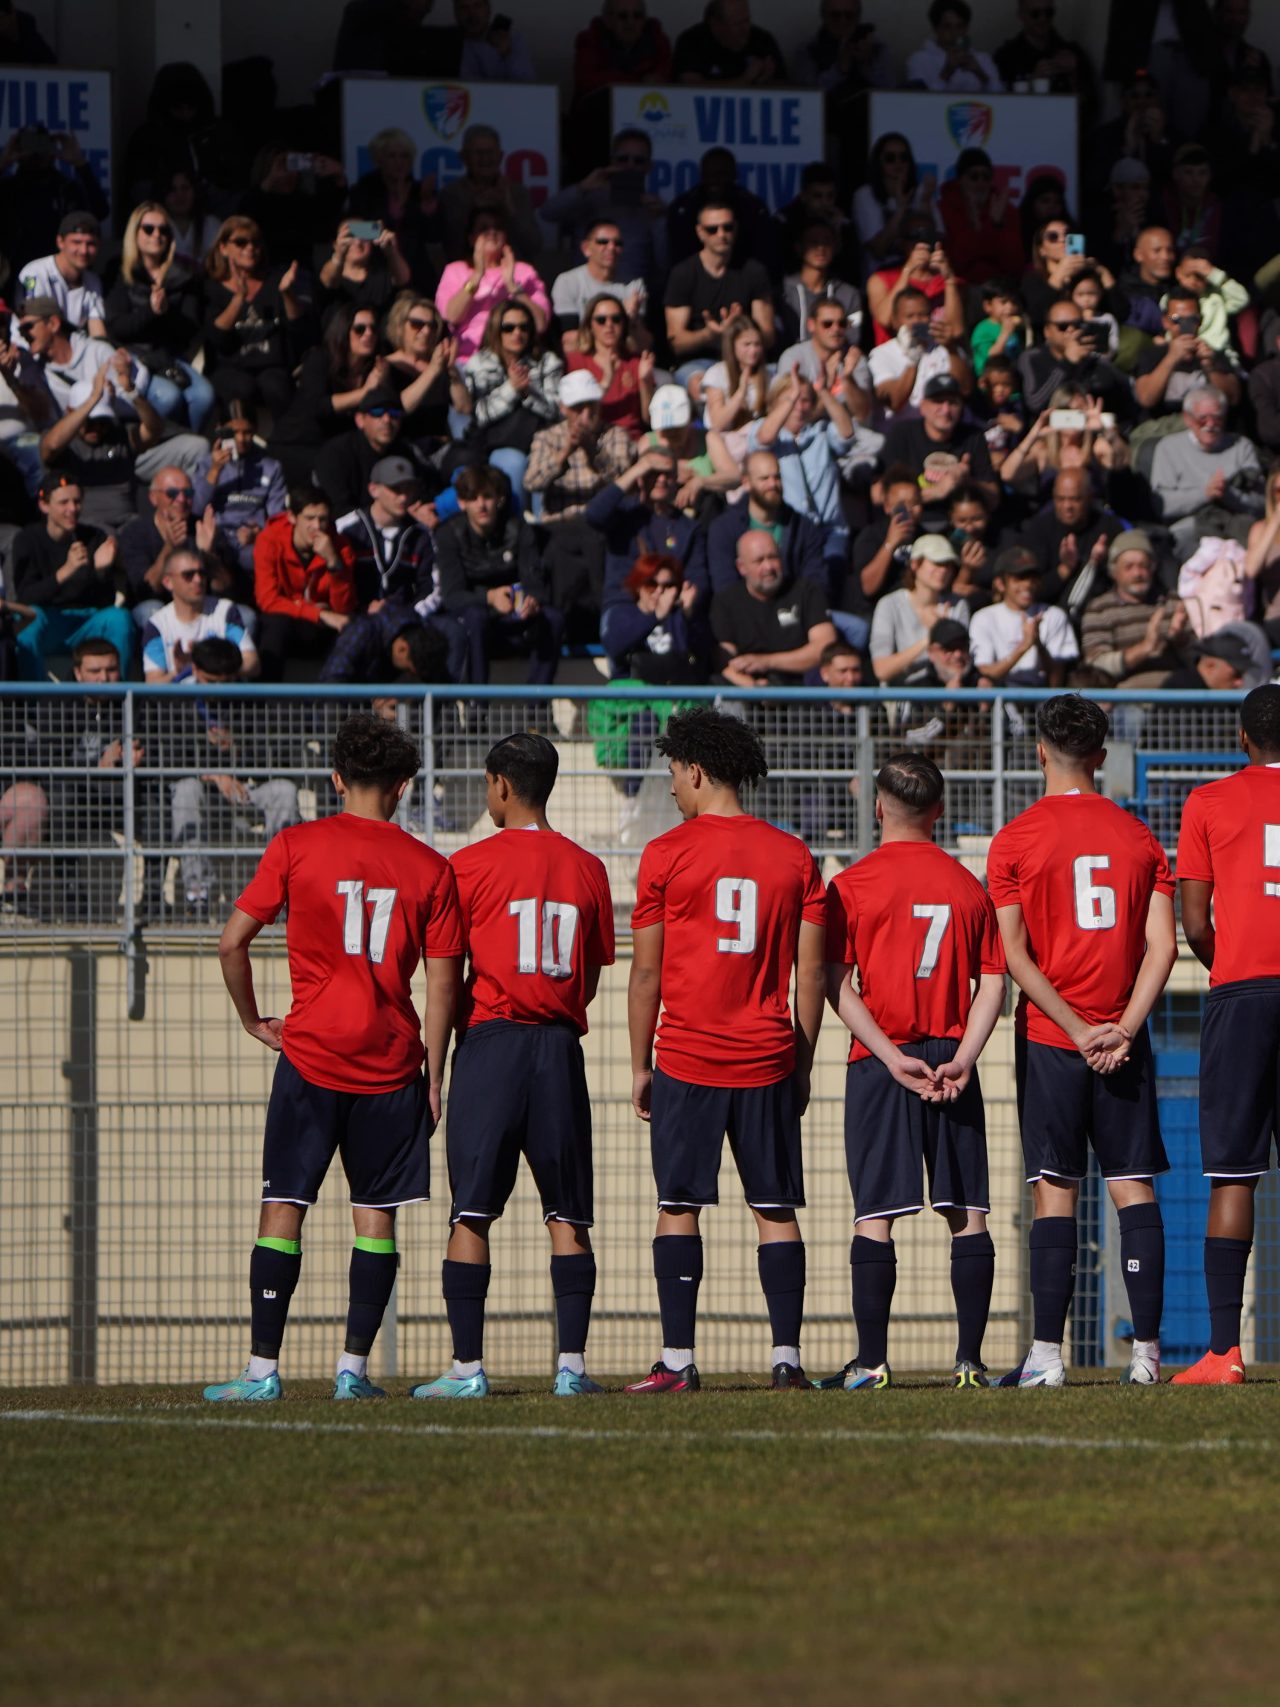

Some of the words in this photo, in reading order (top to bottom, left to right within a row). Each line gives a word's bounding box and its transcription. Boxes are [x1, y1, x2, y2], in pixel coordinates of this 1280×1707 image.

[0, 80, 89, 130] ILLE
[694, 95, 800, 145] VILLE
[335, 879, 398, 965] 11
[714, 876, 759, 955] 9
[1072, 854, 1118, 931] 6
[507, 896, 580, 978] 10
[912, 903, 952, 980] 7
